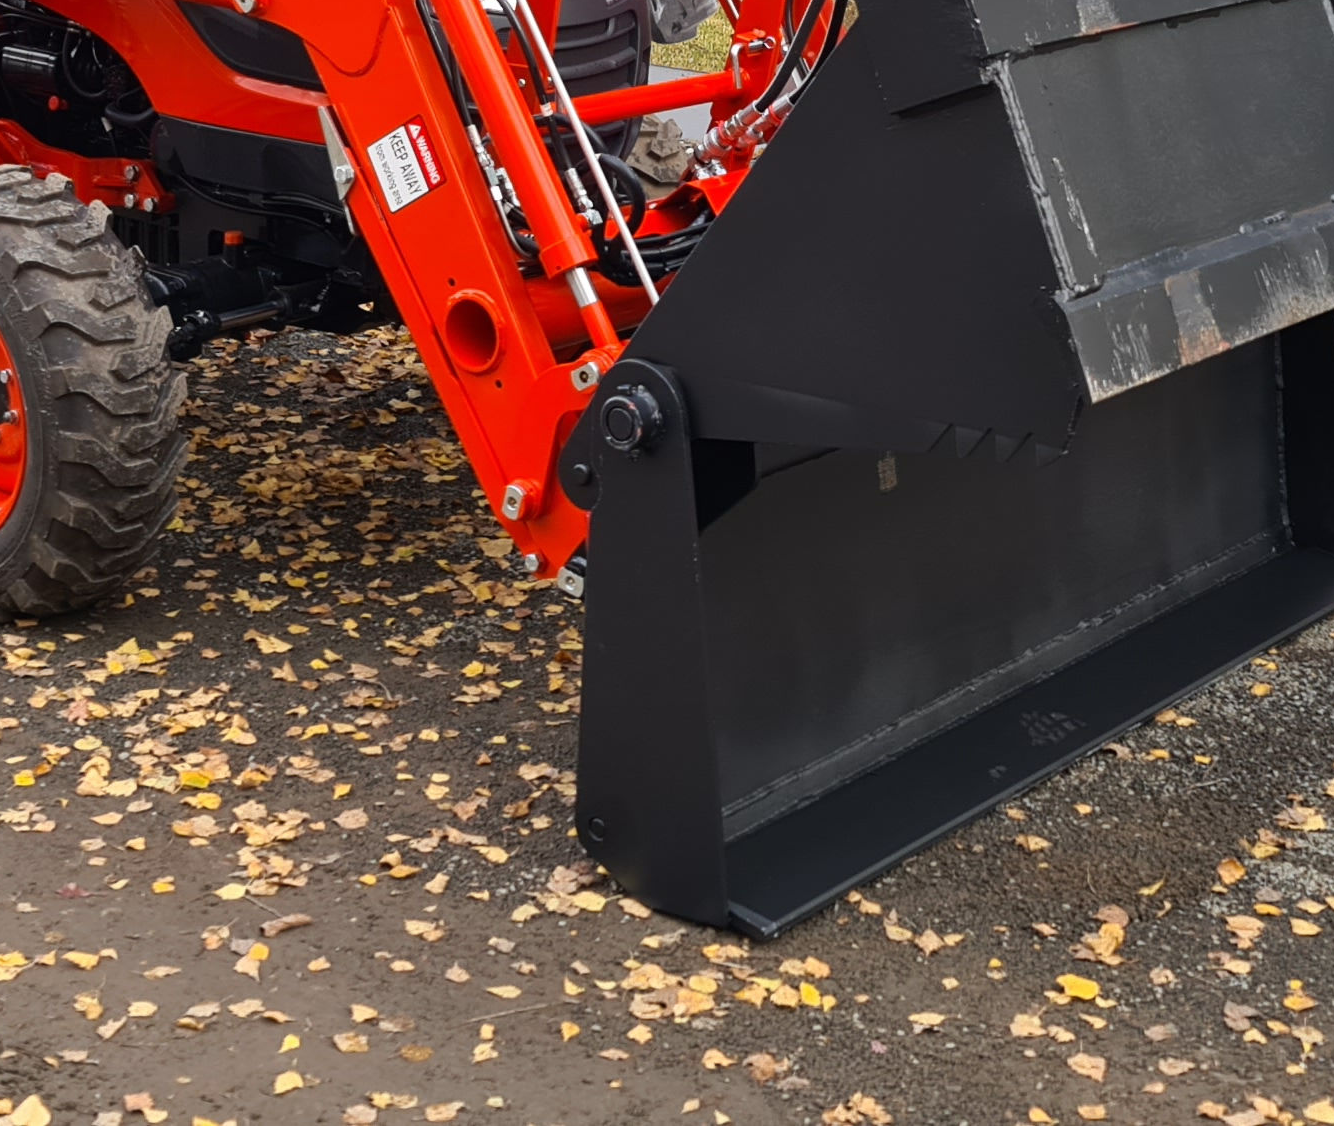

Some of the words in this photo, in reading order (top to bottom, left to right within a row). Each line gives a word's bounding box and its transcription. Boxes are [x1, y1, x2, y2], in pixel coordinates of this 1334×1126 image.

[389, 132, 409, 162] KEEP
[400, 163, 423, 194] AWAY
[416, 135, 441, 185] WARNING
